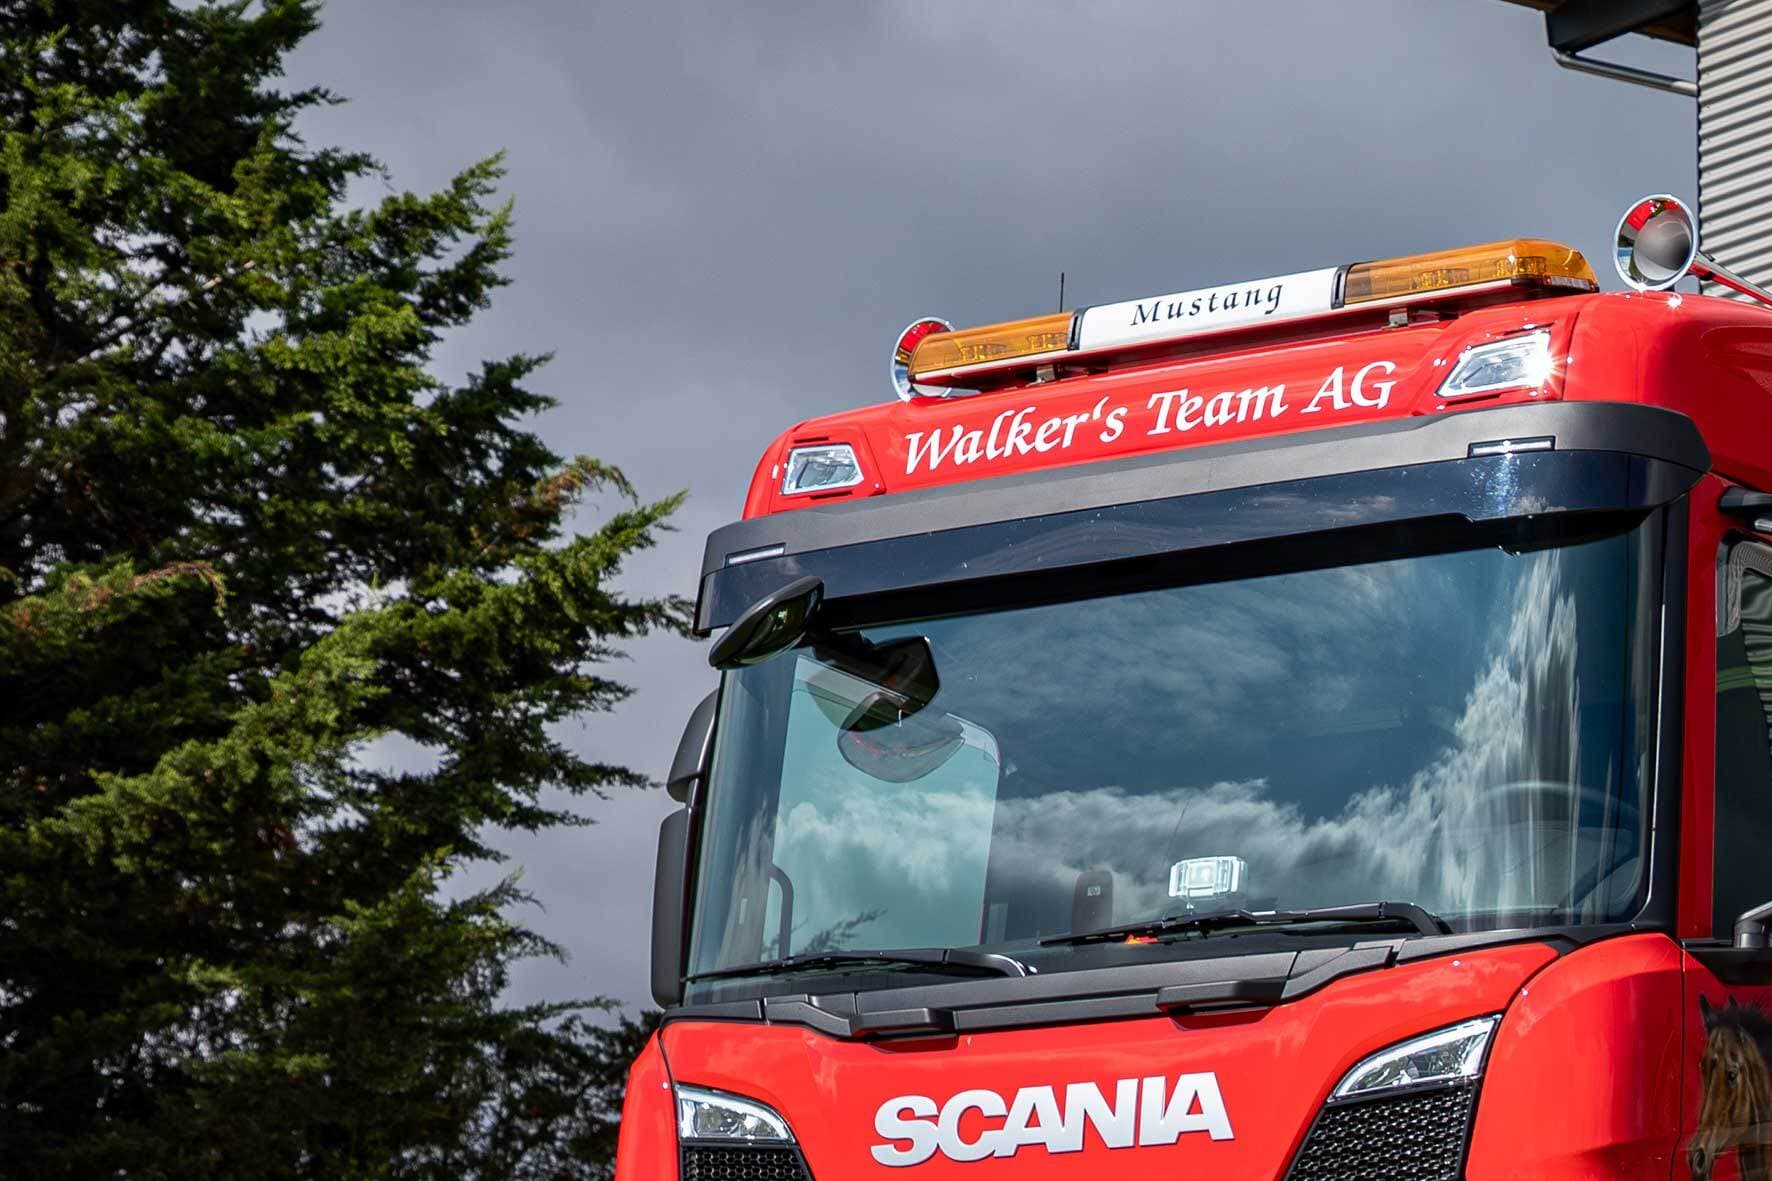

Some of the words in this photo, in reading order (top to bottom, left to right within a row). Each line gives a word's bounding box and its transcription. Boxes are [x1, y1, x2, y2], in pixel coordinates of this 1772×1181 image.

[1130, 284, 1283, 326] Mustang
[905, 396, 1128, 475] Walker's
[1147, 384, 1289, 436] Team
[1300, 360, 1397, 414] AG
[870, 1071, 1235, 1168] SCANIA
